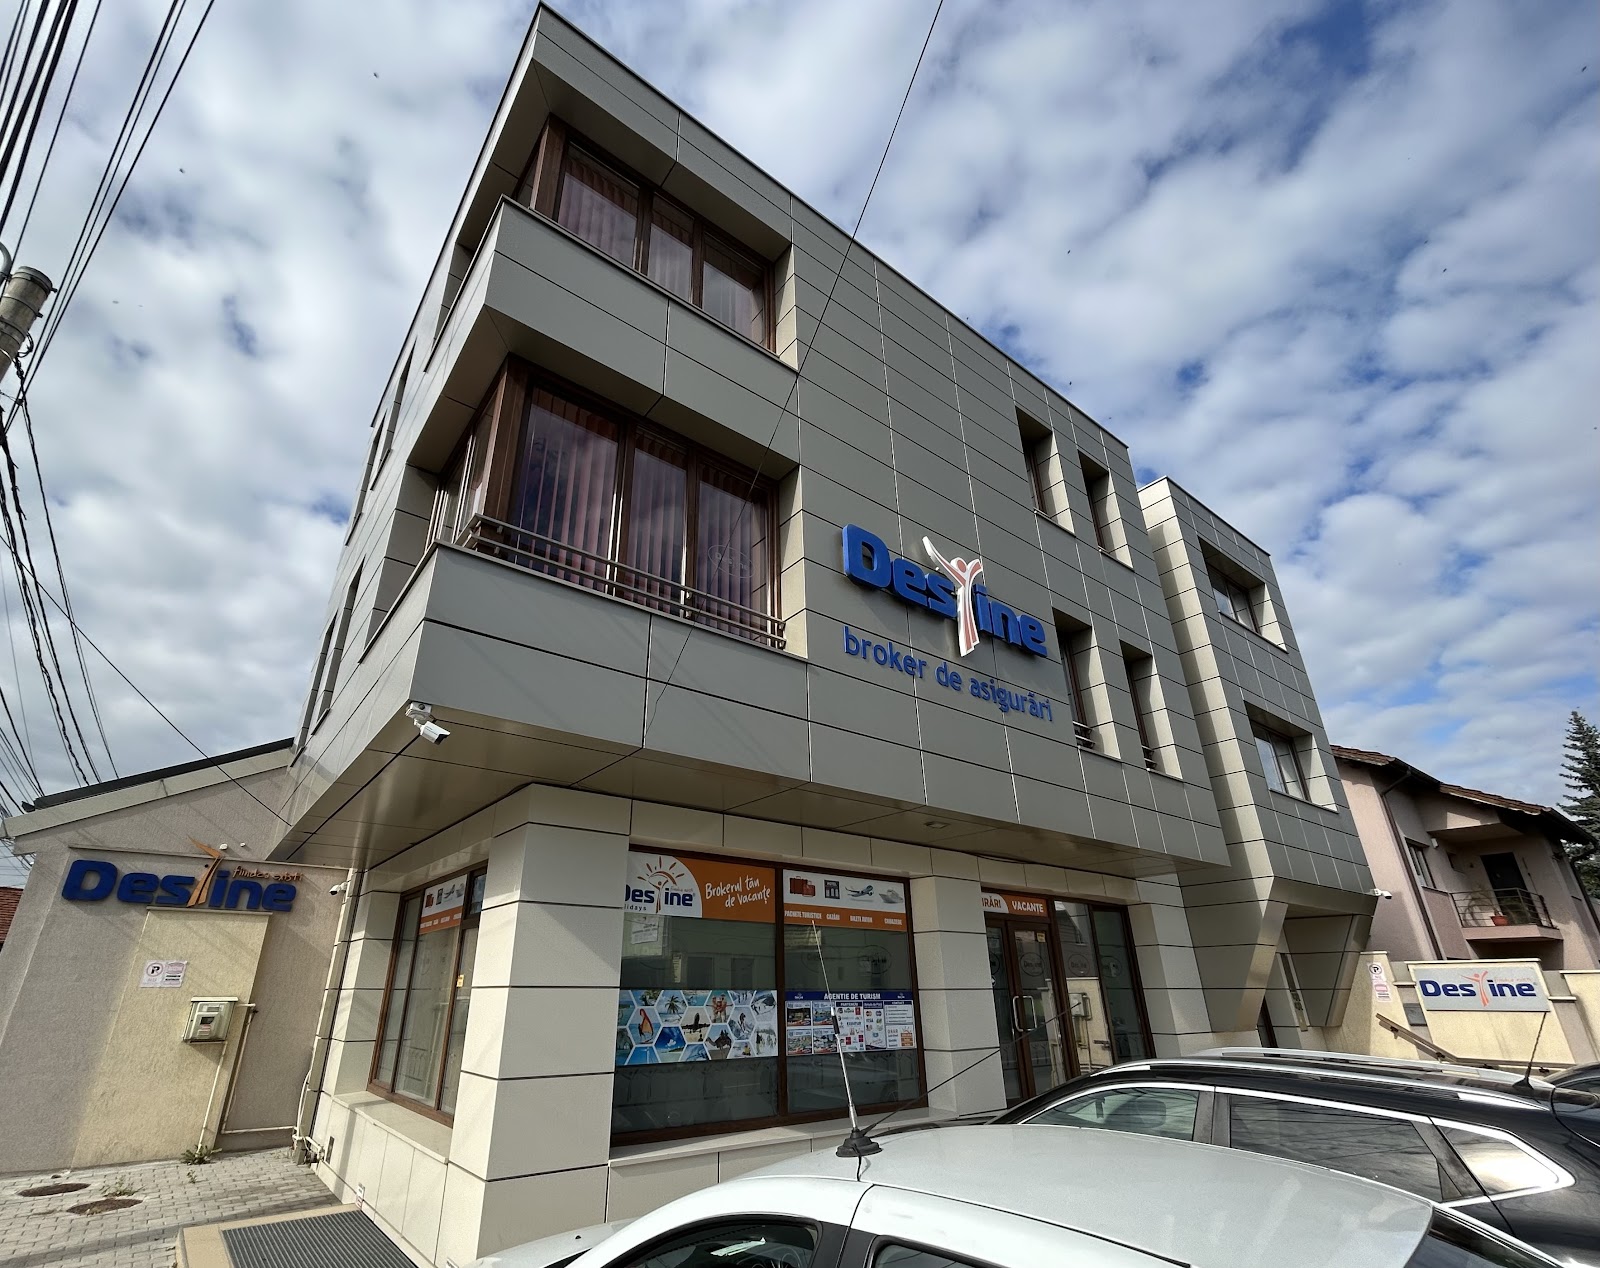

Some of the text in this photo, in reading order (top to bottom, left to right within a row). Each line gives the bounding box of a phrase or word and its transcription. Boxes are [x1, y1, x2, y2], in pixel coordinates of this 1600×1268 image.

[843, 625, 1053, 722] broker de asigurări
[705, 876, 742, 900] Brokerul
[724, 894, 735, 908] de
[982, 895, 1002, 908] RĂRI
[624, 905, 647, 913] lidays
